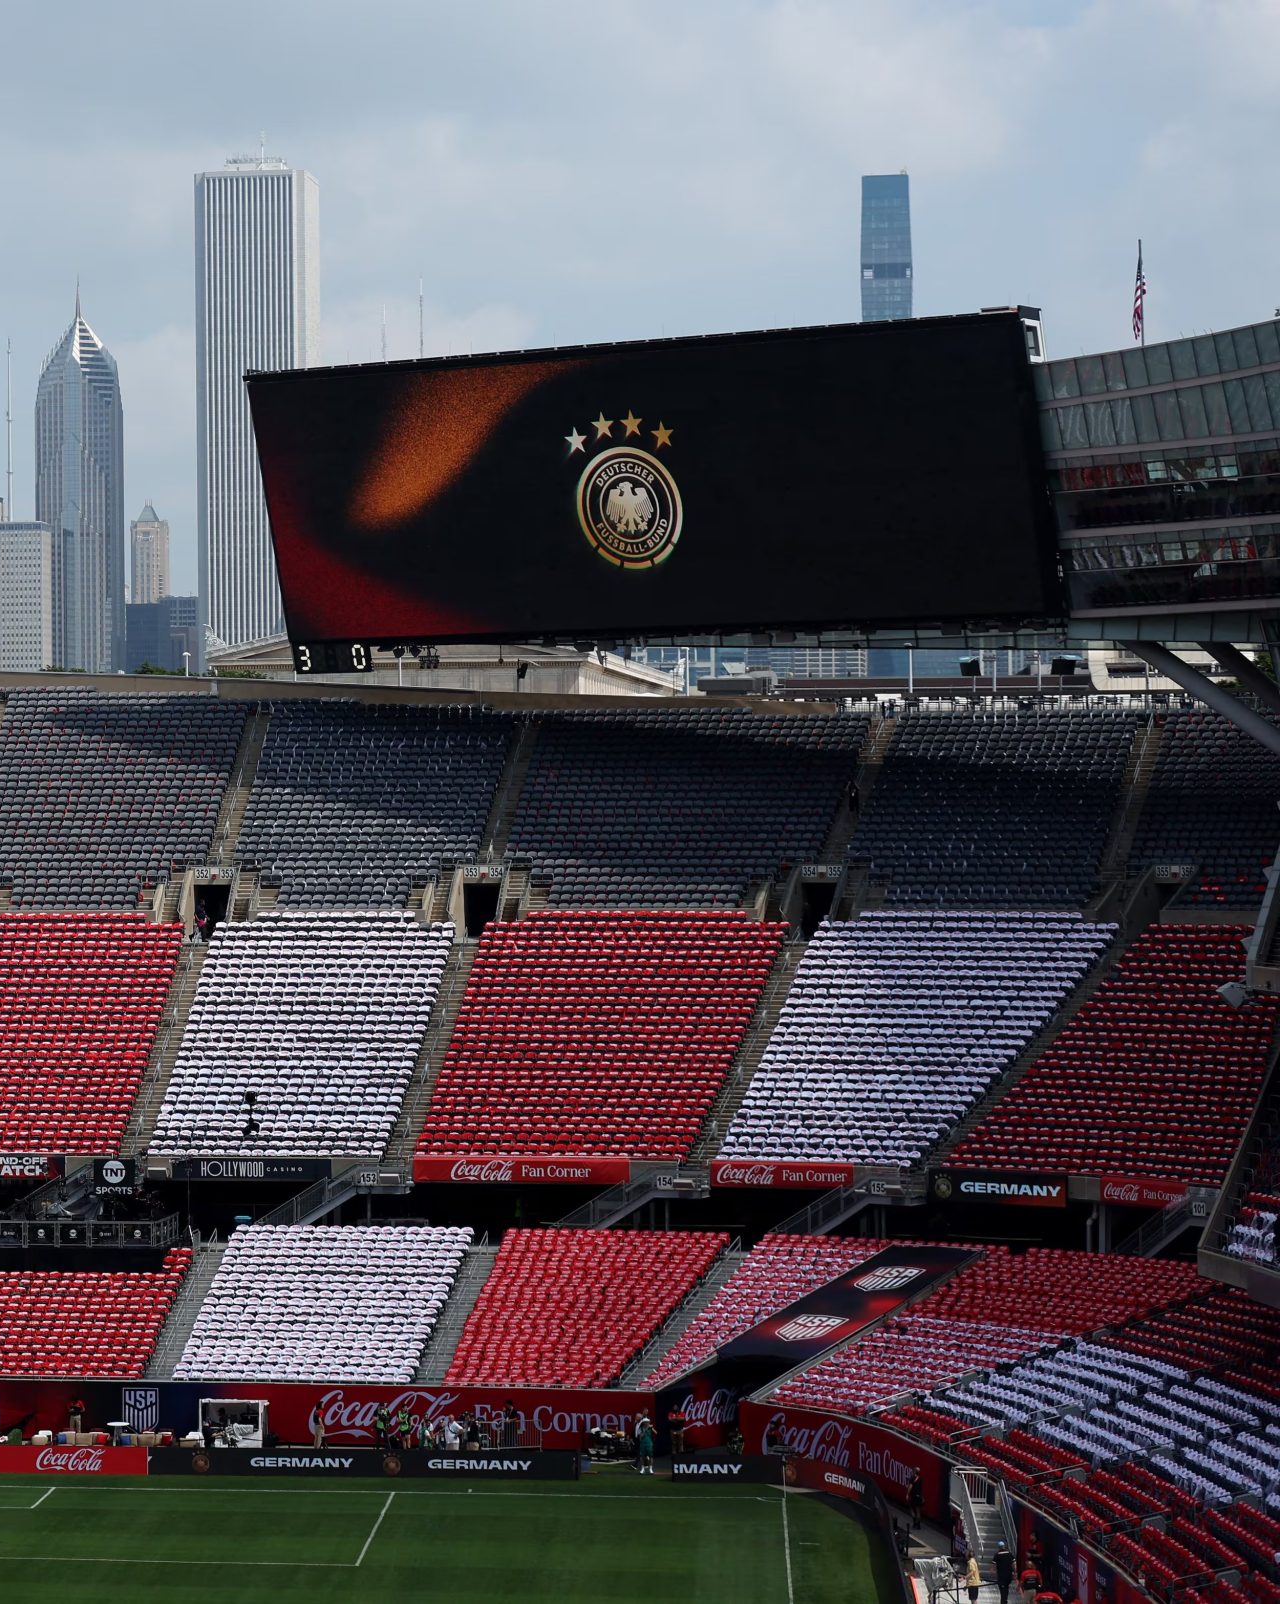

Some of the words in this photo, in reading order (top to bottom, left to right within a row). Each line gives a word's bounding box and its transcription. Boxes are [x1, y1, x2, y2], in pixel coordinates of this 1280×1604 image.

[595, 463, 656, 487] DEUTSCHER
[596, 518, 668, 553] FUSSBALL-BUND
[298, 645, 312, 671] 3
[352, 644, 366, 670] 0
[196, 869, 209, 879] 352
[221, 869, 234, 879] 353
[465, 867, 478, 877] 353
[490, 867, 502, 877] 354
[803, 866, 816, 876] 354
[828, 866, 841, 876] 355
[1156, 867, 1169, 876] 355
[1182, 867, 1193, 877] 356
[200, 1160, 264, 1178] HOLLYWOOD
[450, 1159, 516, 1181] Coca-Cola
[522, 1165, 544, 1177] Fan
[547, 1166, 591, 1178] Corner
[716, 1164, 776, 1185] Coca-Cola
[782, 1170, 803, 1182] Fan
[806, 1170, 848, 1183] Corner
[361, 1174, 376, 1183] 153
[658, 1176, 672, 1186] 154
[96, 1186, 132, 1194] SPORTS
[872, 1182, 886, 1192] 155
[960, 1181, 1061, 1197] GERMANY
[1104, 1182, 1140, 1201] Coca-Cola
[1143, 1189, 1157, 1199] Fan
[1193, 1203, 1205, 1212] 101
[874, 1267, 920, 1278] USA
[796, 1316, 842, 1327] USA
[125, 1391, 156, 1409] USA
[474, 1404, 526, 1431] Fan
[533, 1405, 632, 1433] Corner
[35, 1447, 106, 1472] Coca-Cola
[250, 1457, 353, 1468] GERMANY
[859, 1441, 880, 1474] Fan
[428, 1459, 532, 1471] GERMANY
[824, 1472, 866, 1494] GERMANY
